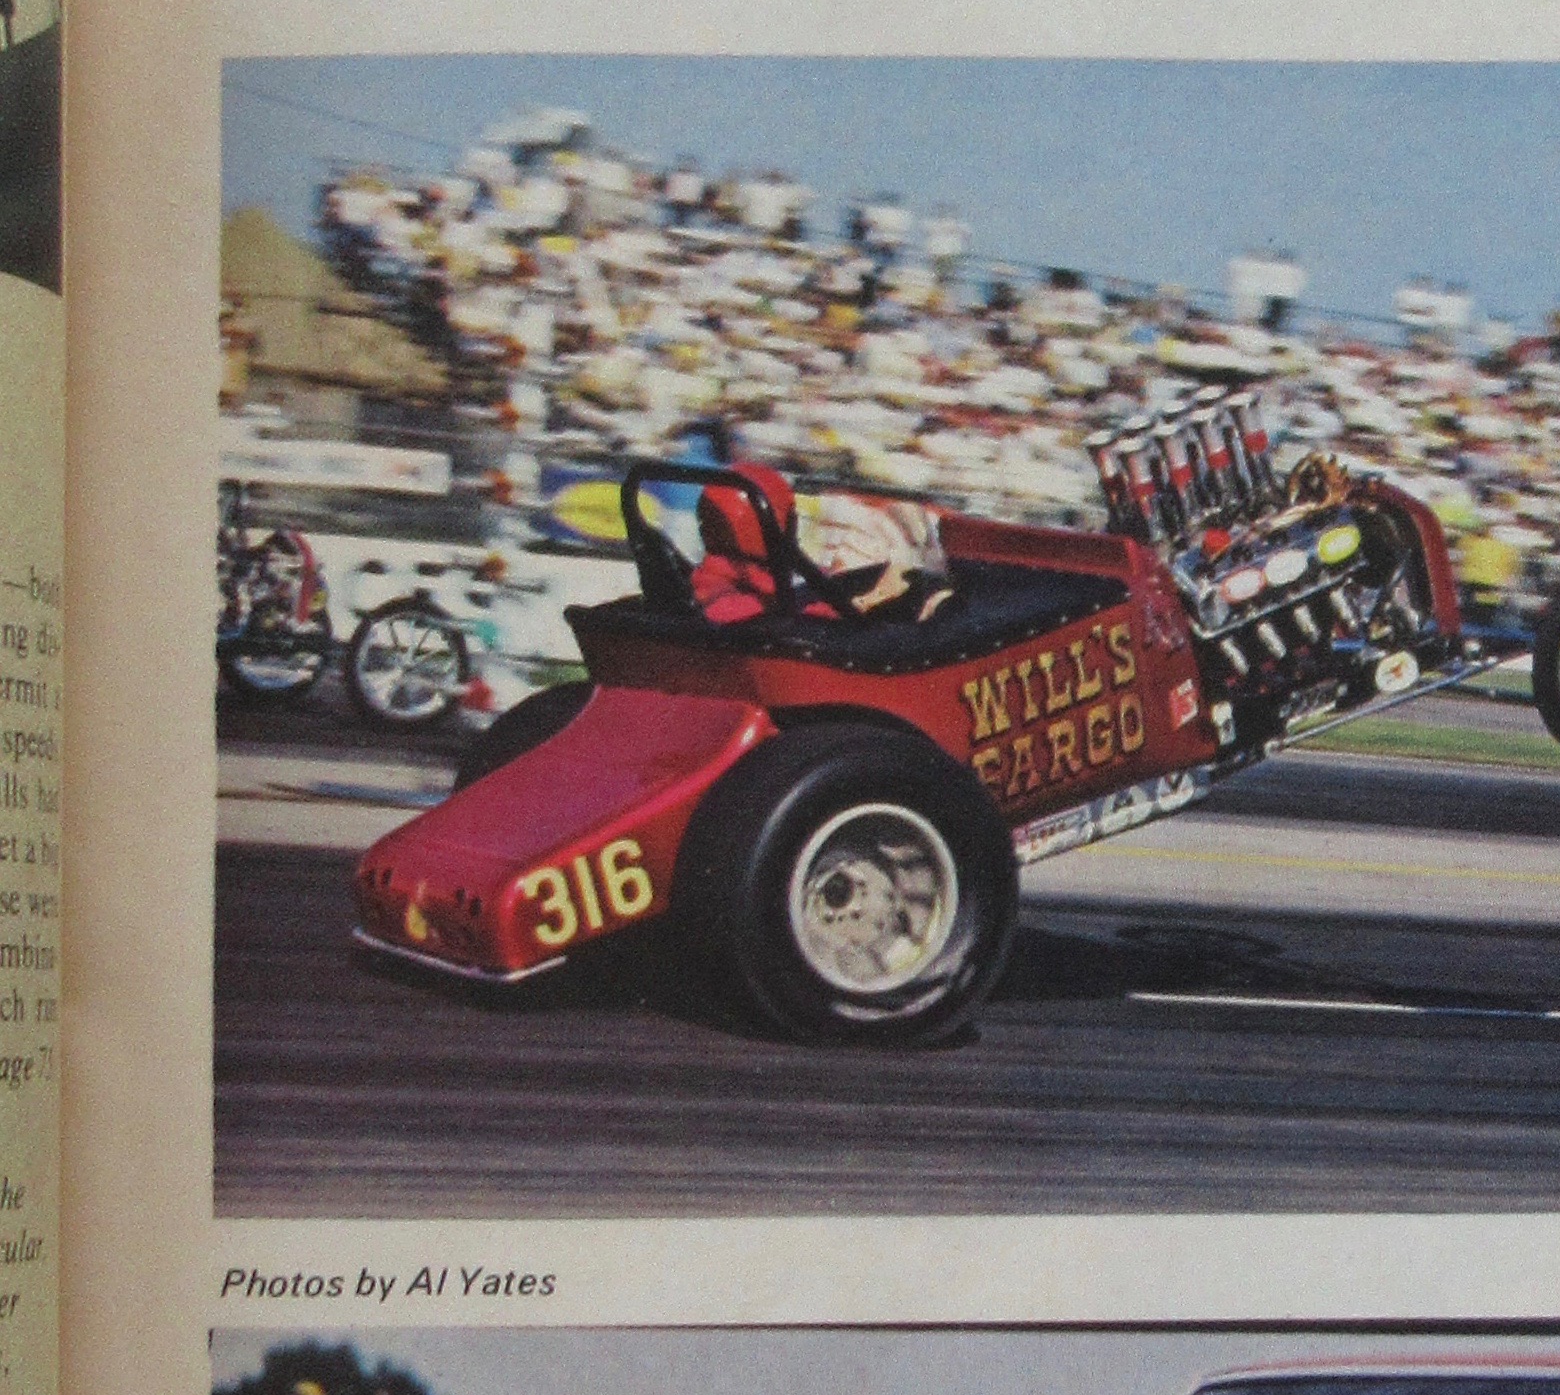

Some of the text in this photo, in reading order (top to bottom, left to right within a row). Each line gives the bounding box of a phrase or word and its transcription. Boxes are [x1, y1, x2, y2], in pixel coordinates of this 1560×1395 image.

[963, 623, 1136, 742] WILL'S
[971, 693, 1144, 798] FARGO
[518, 840, 656, 947] 316
[219, 1266, 556, 1303] Photos by Al Yates
